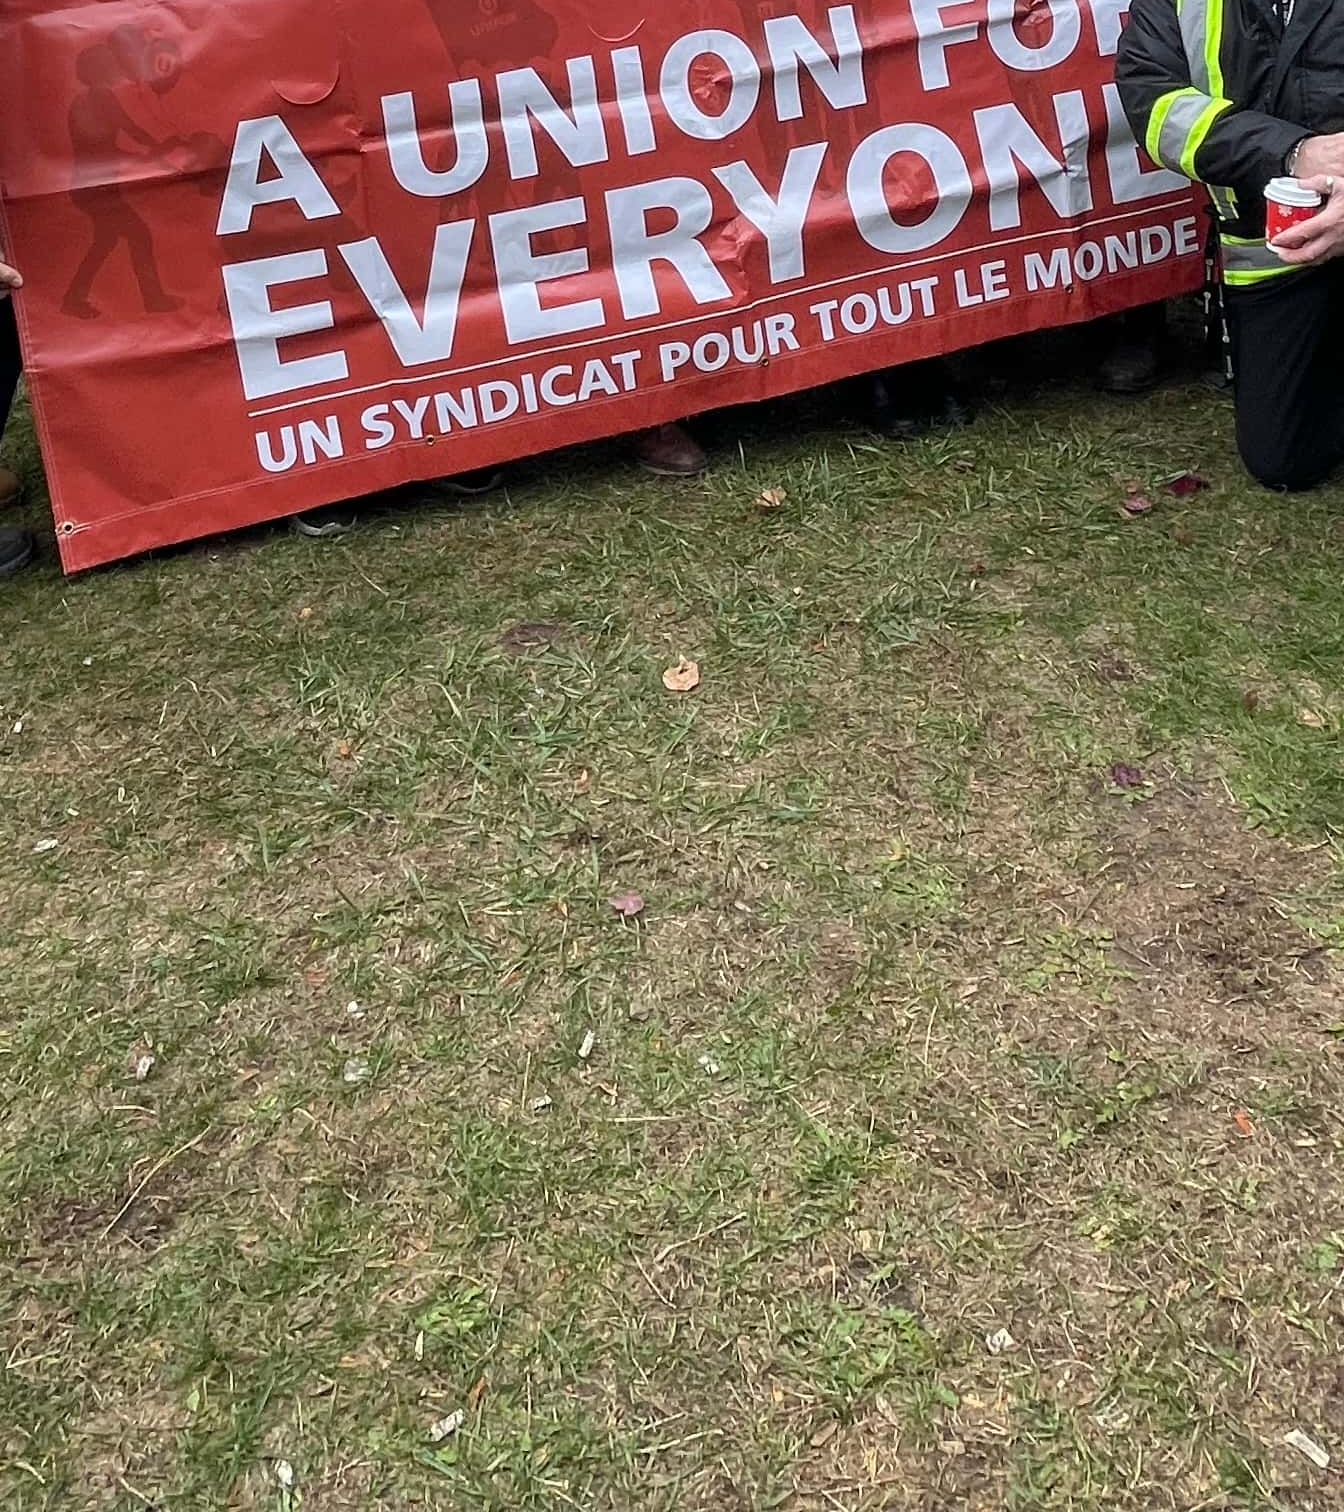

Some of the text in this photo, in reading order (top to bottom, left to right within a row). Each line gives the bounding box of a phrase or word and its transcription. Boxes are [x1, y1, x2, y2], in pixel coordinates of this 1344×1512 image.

[216, 114, 341, 236] A
[380, 4, 868, 198] UNION
[255, 215, 1201, 473] UN SYNDICAT POUR TOUT LE MONDE
